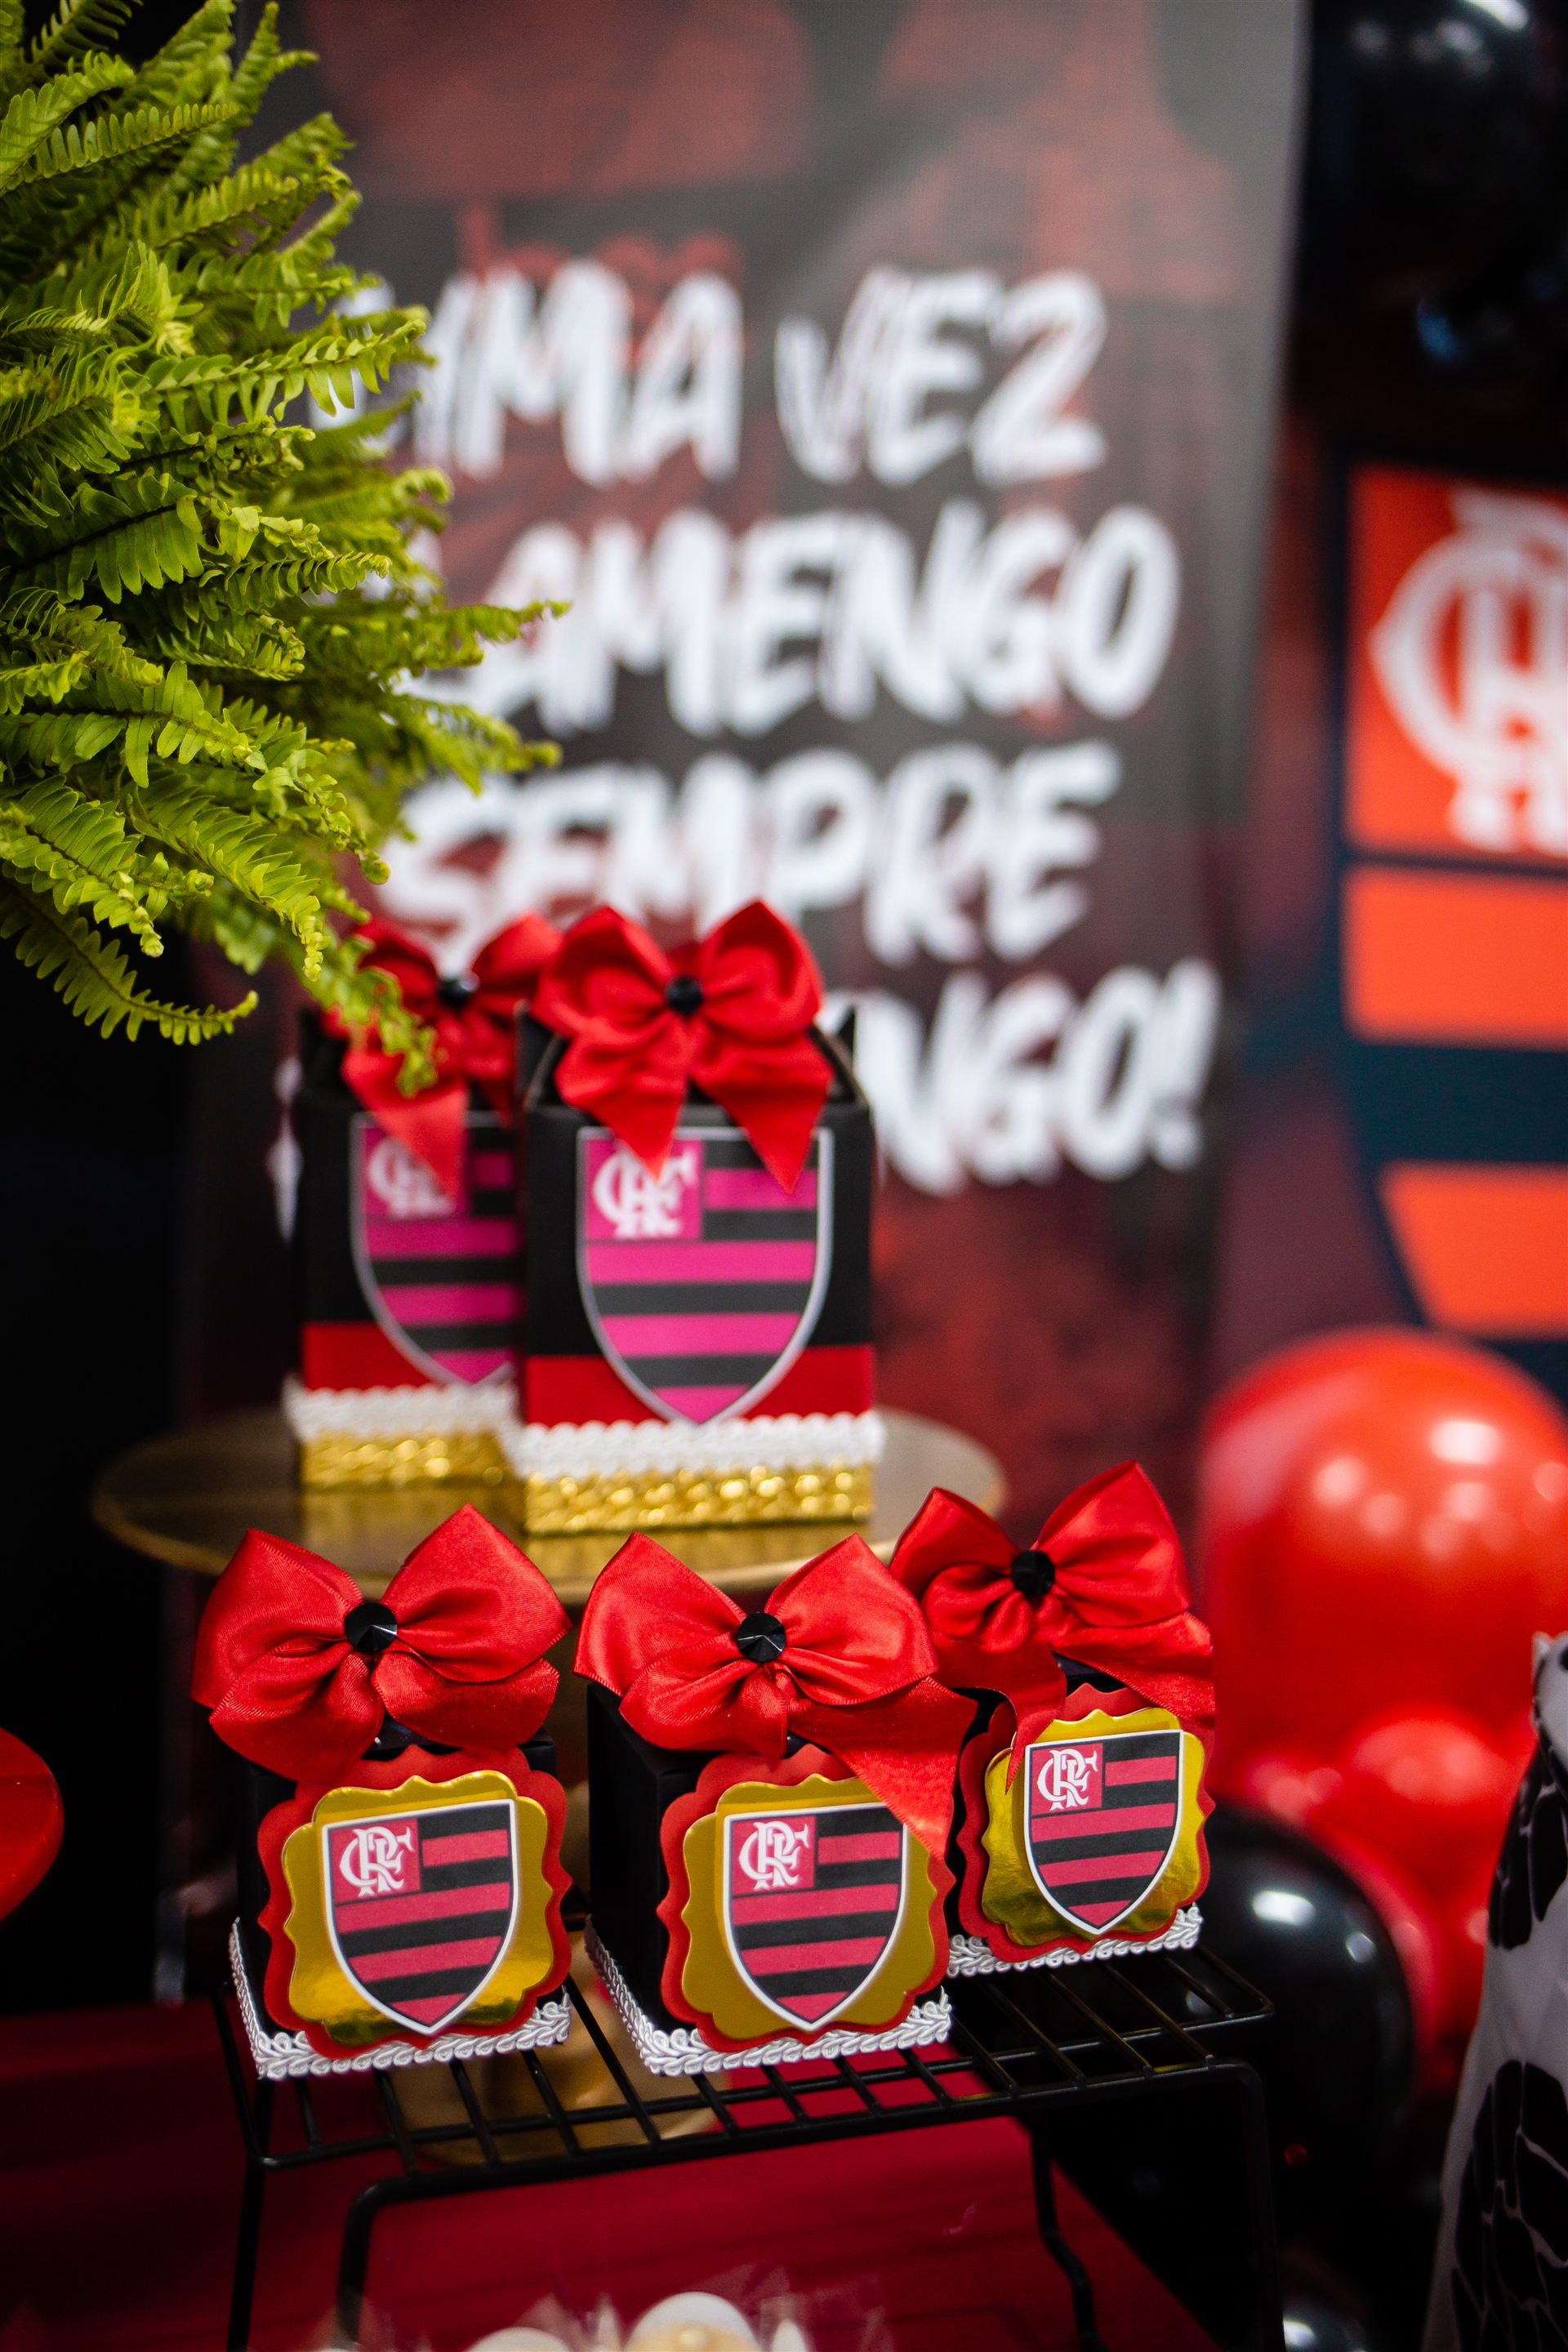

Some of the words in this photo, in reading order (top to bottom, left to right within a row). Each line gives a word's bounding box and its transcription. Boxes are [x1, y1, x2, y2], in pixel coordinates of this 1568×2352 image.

[773, 266, 1108, 488] VEZ
[384, 498, 1182, 737] AMENGO
[372, 739, 1123, 972] SEMPRE
